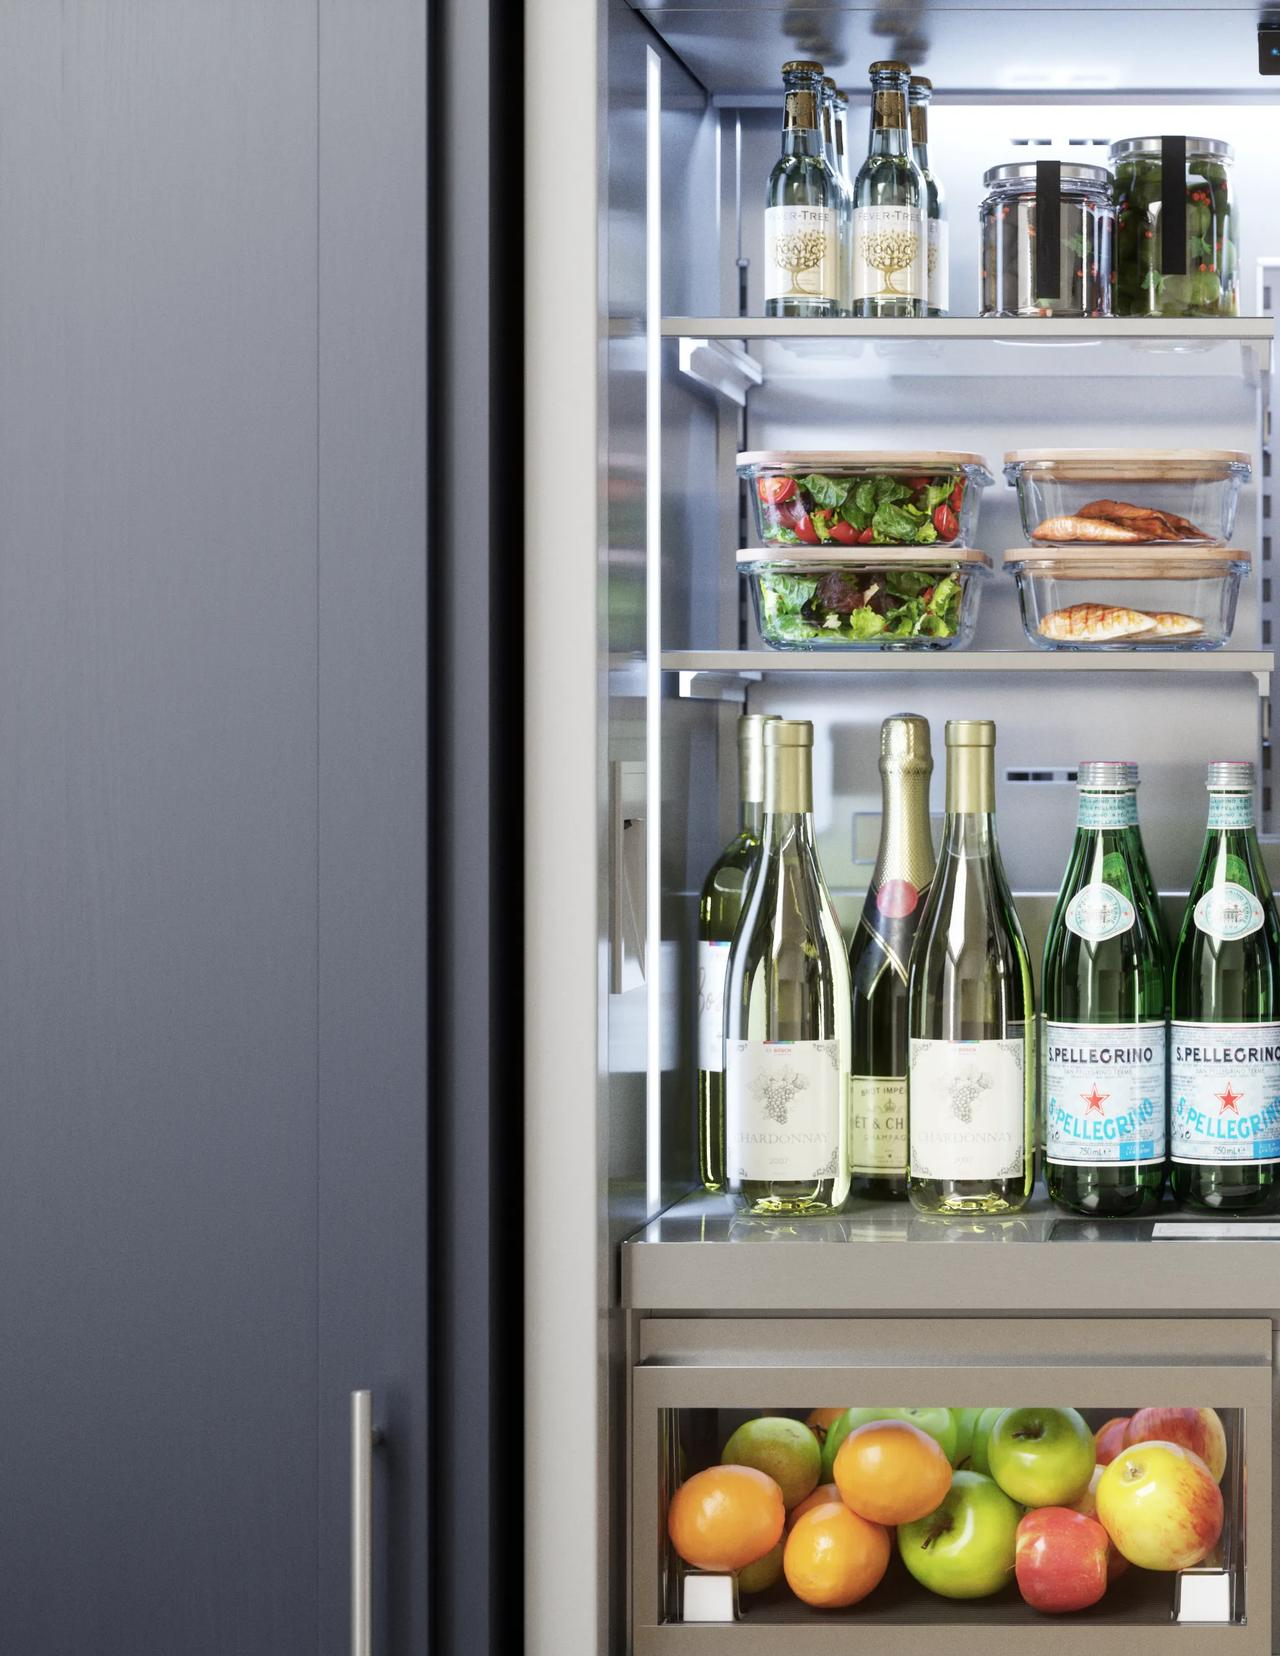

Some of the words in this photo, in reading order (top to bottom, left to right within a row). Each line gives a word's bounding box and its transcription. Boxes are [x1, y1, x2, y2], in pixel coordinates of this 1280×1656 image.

[1048, 1046, 1153, 1064] S.PELLEGRINO
[872, 1118, 882, 1130] &
[736, 1131, 830, 1145] HARDONNAY
